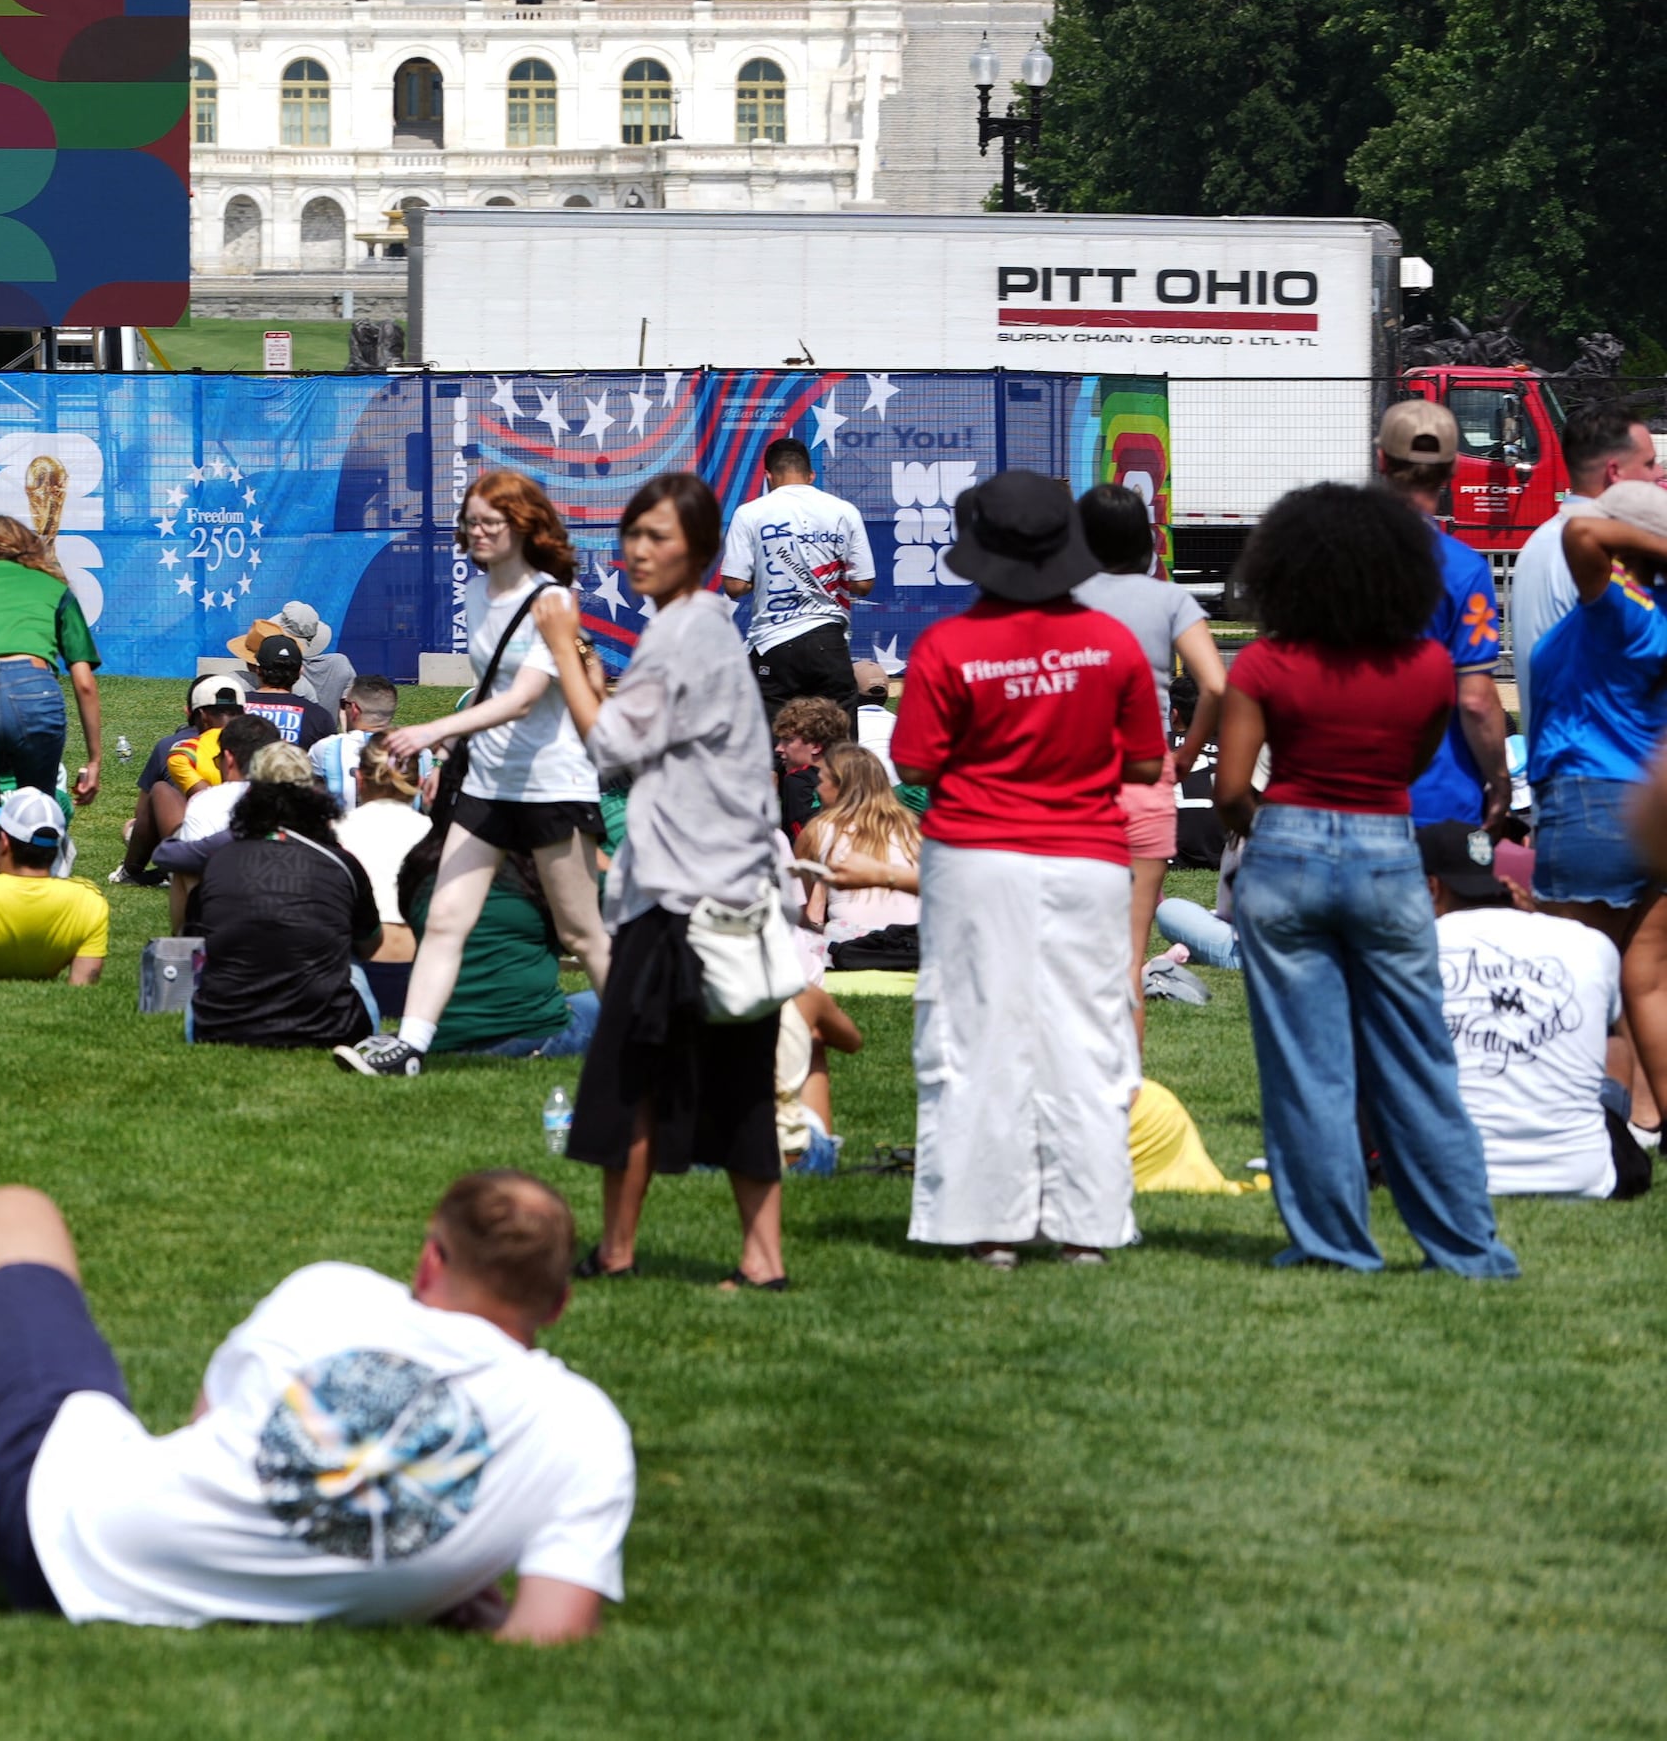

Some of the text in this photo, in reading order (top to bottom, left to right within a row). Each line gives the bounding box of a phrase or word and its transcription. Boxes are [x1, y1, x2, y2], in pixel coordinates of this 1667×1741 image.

[998, 266, 1318, 306] PITT OHIO
[997, 332, 1319, 347] SUPPLY CHAIN GROUND LTL TL
[893, 426, 973, 449] You!
[1460, 485, 1489, 494] PITT
[186, 507, 245, 524] Freedom
[186, 526, 245, 572] 250
[798, 530, 845, 545] adidas
[962, 647, 1111, 683] Fitness Center
[1004, 670, 1079, 699] STAFF
